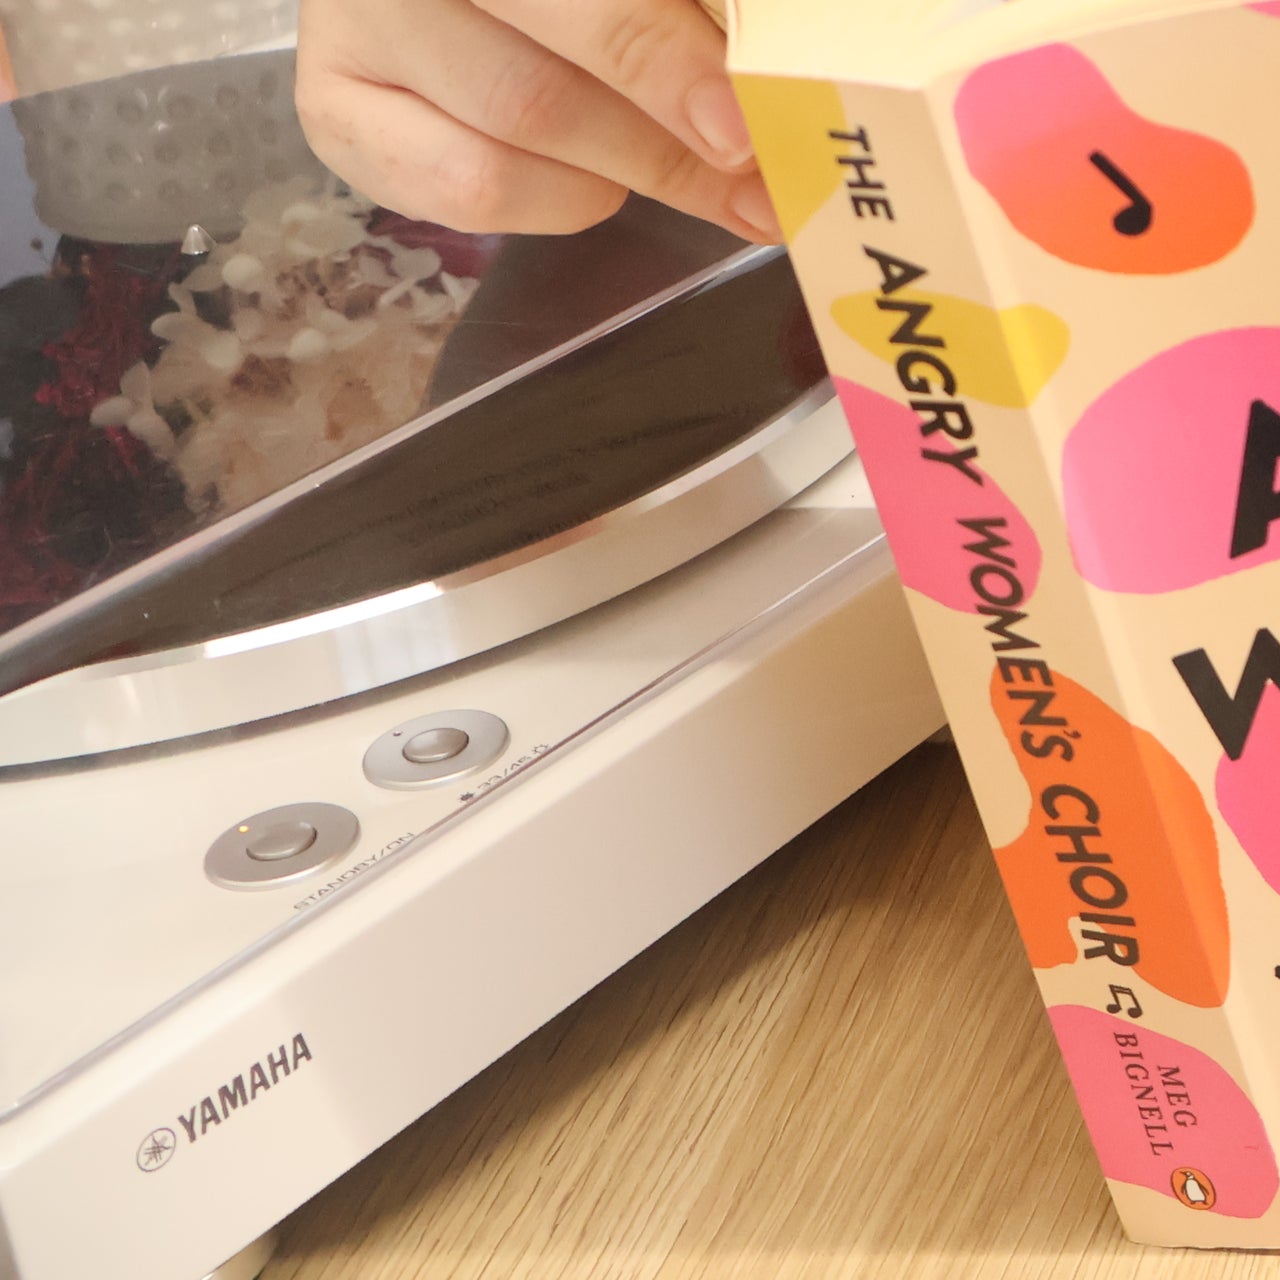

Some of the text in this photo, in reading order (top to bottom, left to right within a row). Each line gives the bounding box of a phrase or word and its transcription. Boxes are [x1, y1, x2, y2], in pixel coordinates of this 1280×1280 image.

[828, 126, 896, 221] THE
[862, 244, 984, 487] ANGRY
[1040, 783, 1140, 967] CHOIR
[177, 1032, 312, 1144] YAMAHA
[1113, 1032, 1174, 1156] BIGNELL
[1157, 1065, 1197, 1128] MEG
